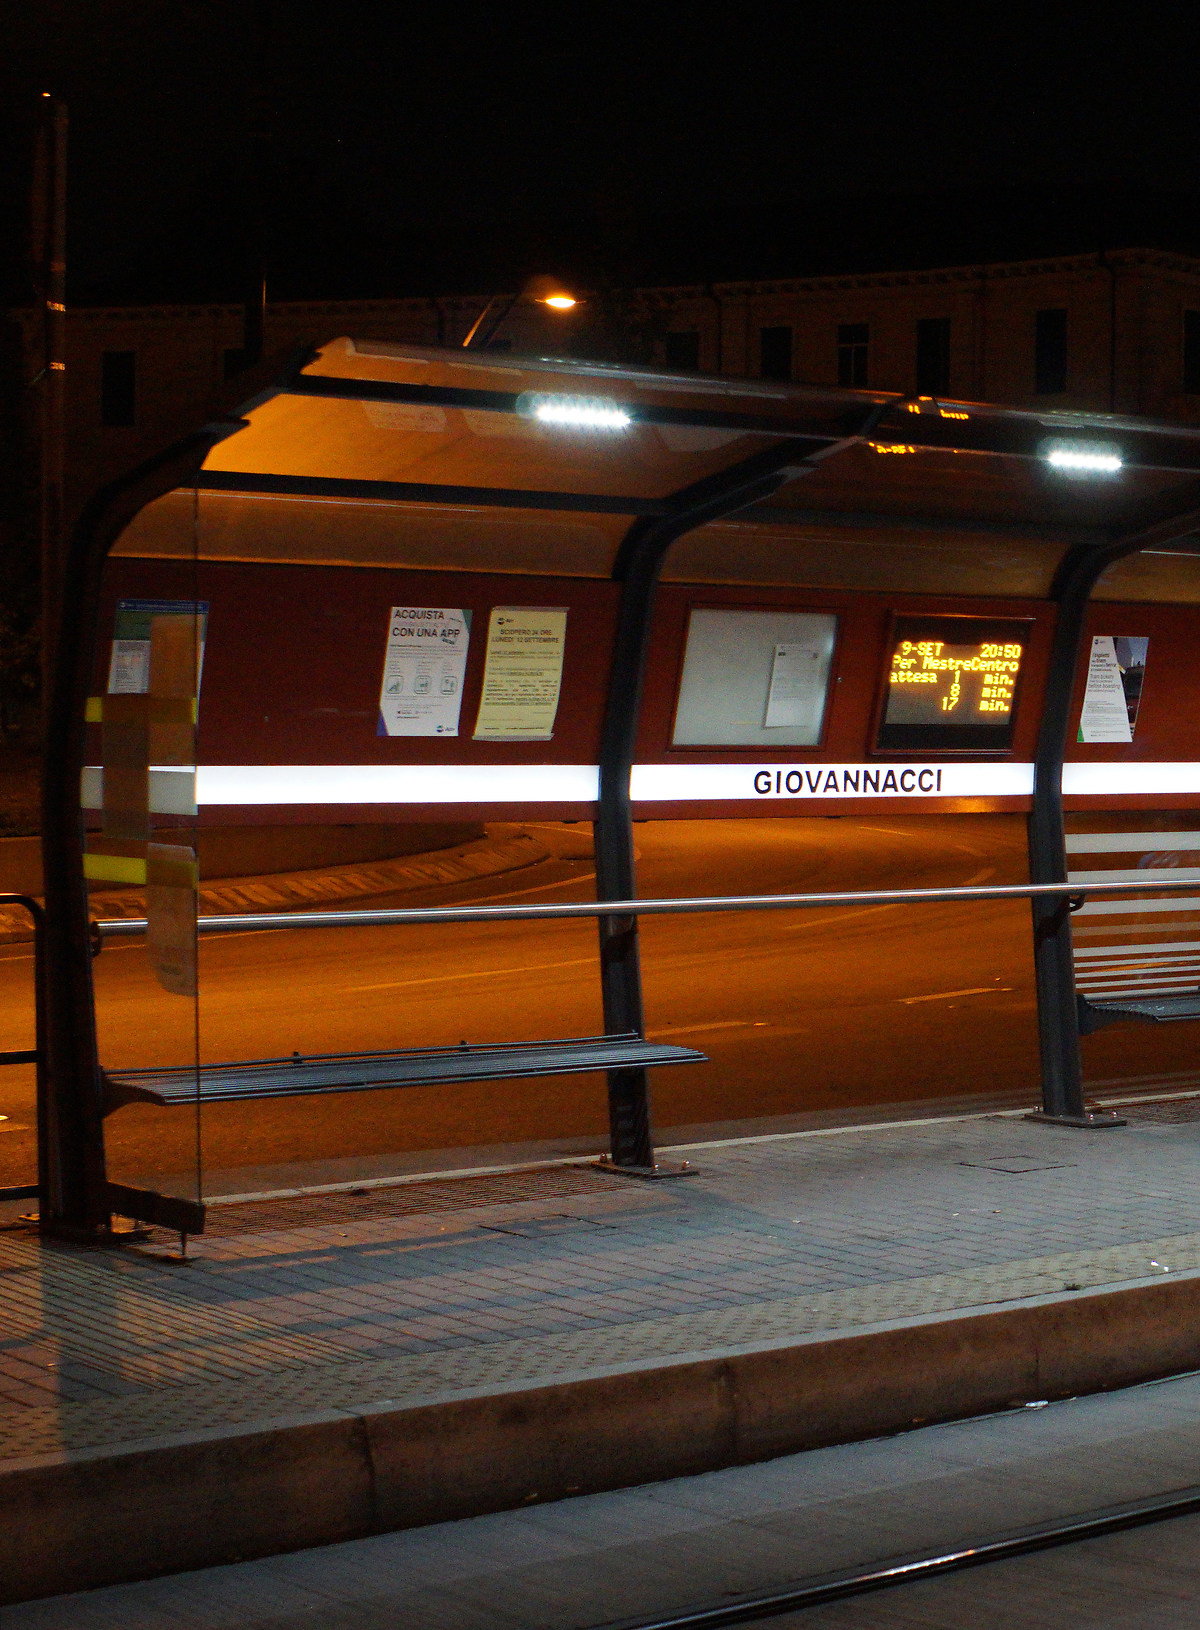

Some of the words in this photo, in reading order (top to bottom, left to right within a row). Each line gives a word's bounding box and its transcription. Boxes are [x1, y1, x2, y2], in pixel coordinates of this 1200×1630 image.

[394, 609, 445, 620] ACQUISTA
[392, 627, 414, 637] CON
[416, 627, 438, 638] UNA
[440, 628, 461, 639] APP
[902, 641, 945, 656] 9-SET
[980, 644, 1022, 659] 20:50
[893, 654, 917, 669] Per
[922, 656, 1019, 672] MestreCentro
[890, 670, 938, 683] attesa
[954, 669, 960, 684] 1
[984, 673, 1014, 686] min.
[950, 683, 961, 697] 8
[982, 686, 1012, 699] min.
[942, 697, 959, 711] 17
[979, 699, 1010, 712] min.
[754, 769, 942, 794] GIOVANNACCI
